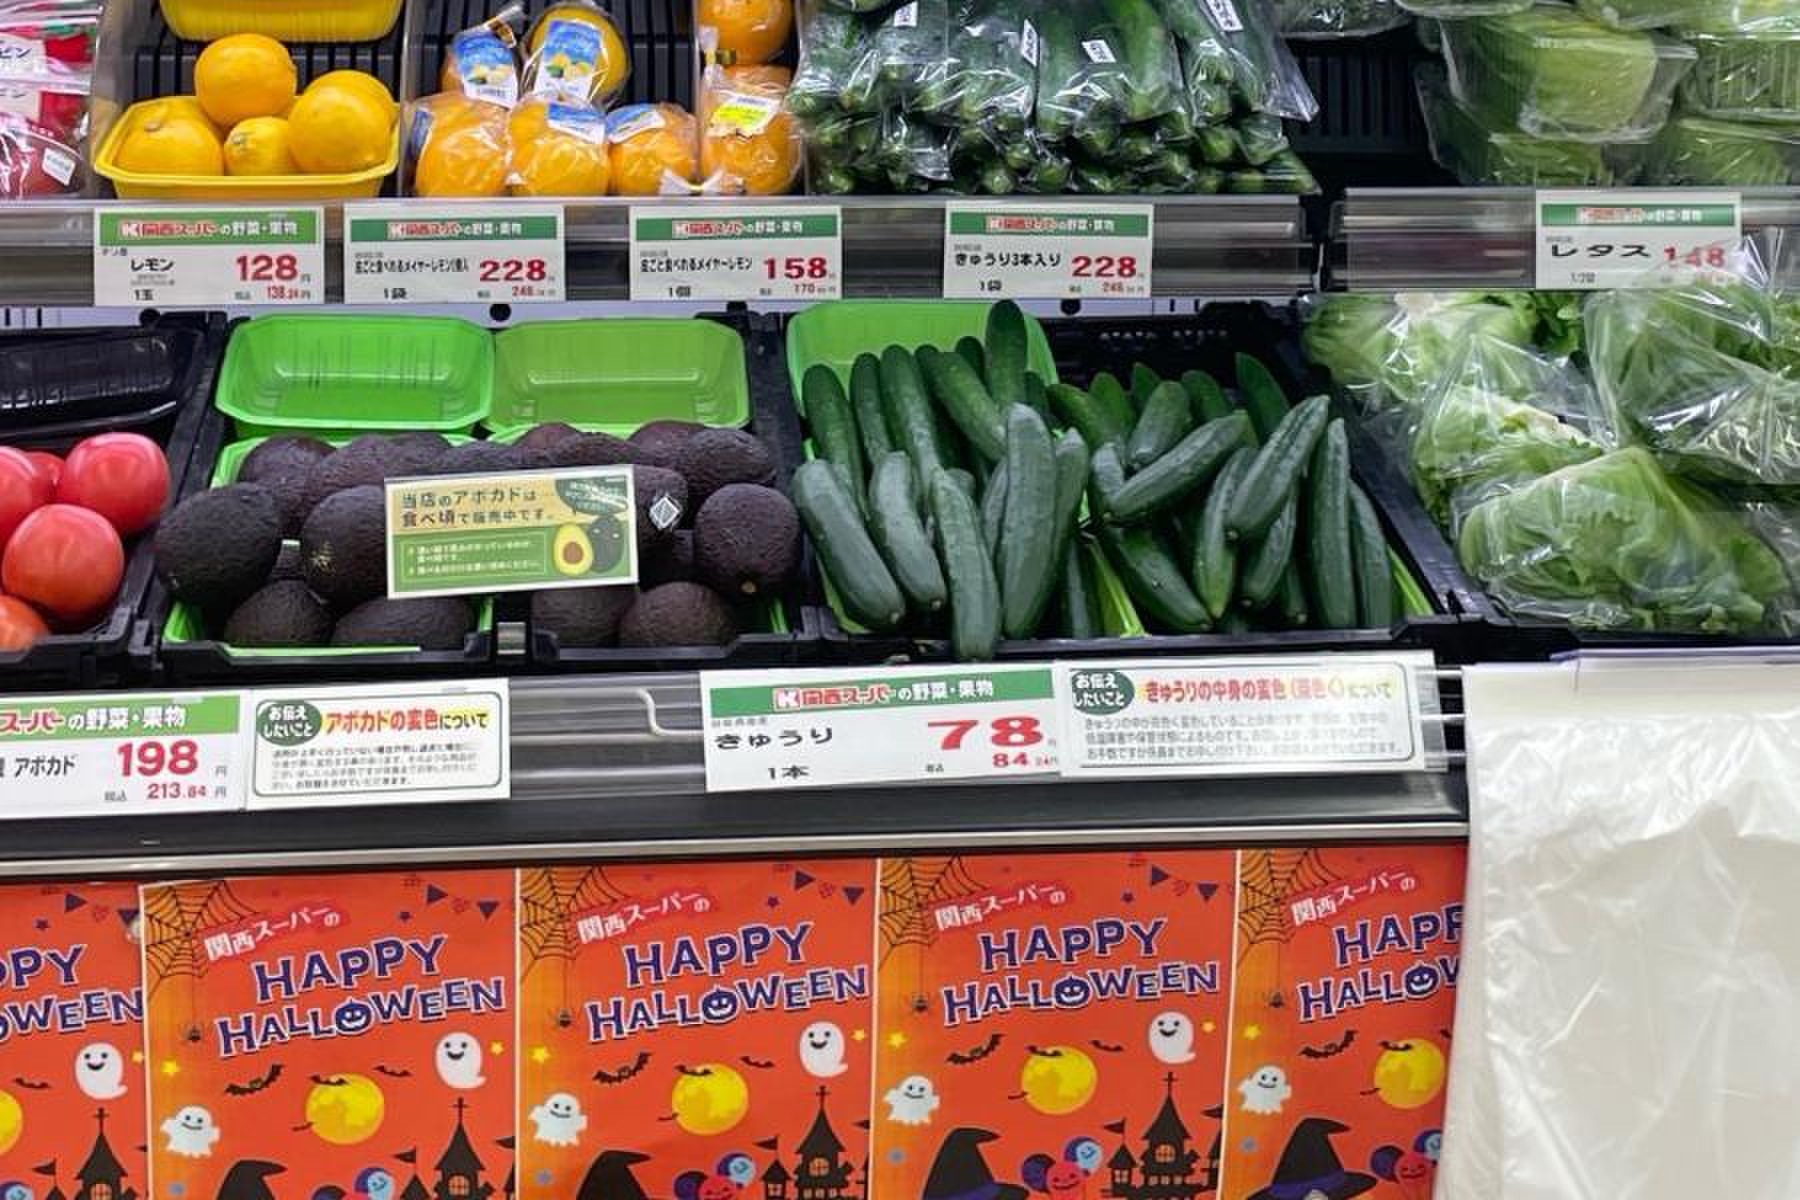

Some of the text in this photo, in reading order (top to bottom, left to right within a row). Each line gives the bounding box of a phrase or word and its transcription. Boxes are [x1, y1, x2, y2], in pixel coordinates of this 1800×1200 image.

[130, 257, 175, 272] レモン
[236, 254, 298, 282] 128
[763, 257, 827, 280] 158
[954, 252, 1061, 267] きゅうり3本入り
[1071, 256, 1137, 278] 228
[1551, 244, 1650, 258] レタス
[479, 259, 546, 282] 228
[263, 722, 313, 738] したいこと
[714, 727, 833, 750] きゅうり
[927, 715, 1044, 750] 78
[15, 754, 76, 778] アボカド
[117, 739, 199, 777] 198
[767, 765, 809, 780] 1本
[934, 879, 1066, 932] 関西スーパーの
[1290, 870, 1416, 926] 関西スーパーの
[203, 906, 340, 962] 関西スーパーの
[575, 890, 712, 944] 関西スーパーの
[623, 919, 813, 990] HAPPY
[977, 916, 1167, 974] HAPPY
[253, 932, 449, 1003] HAPPY
[586, 965, 870, 1043] HALLOWEEN
[942, 961, 1219, 1027] HALLOWEEN
[214, 976, 506, 1058] HALLOWEEN
